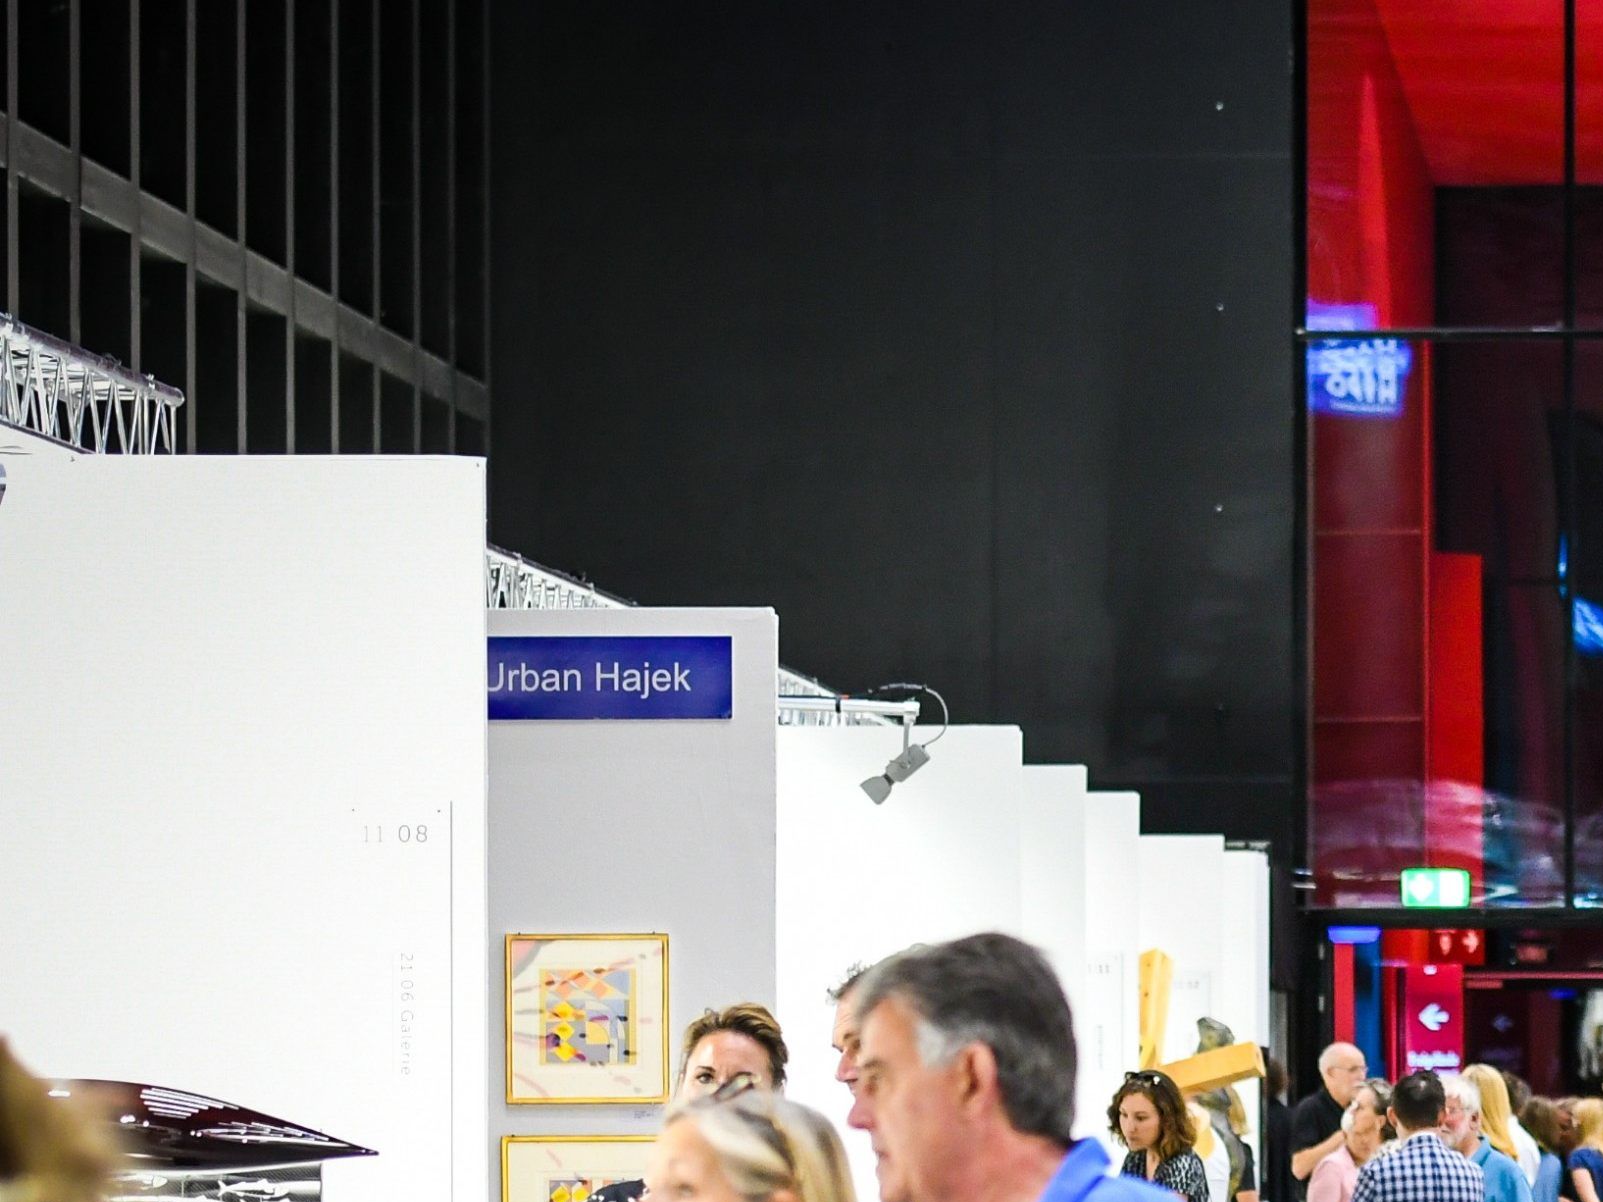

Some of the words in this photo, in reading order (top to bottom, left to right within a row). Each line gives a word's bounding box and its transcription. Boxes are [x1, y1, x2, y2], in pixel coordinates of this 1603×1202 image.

[488, 662, 582, 693] Urban
[595, 662, 692, 699] Hajek
[362, 825, 383, 843] 11
[398, 824, 429, 843] 08
